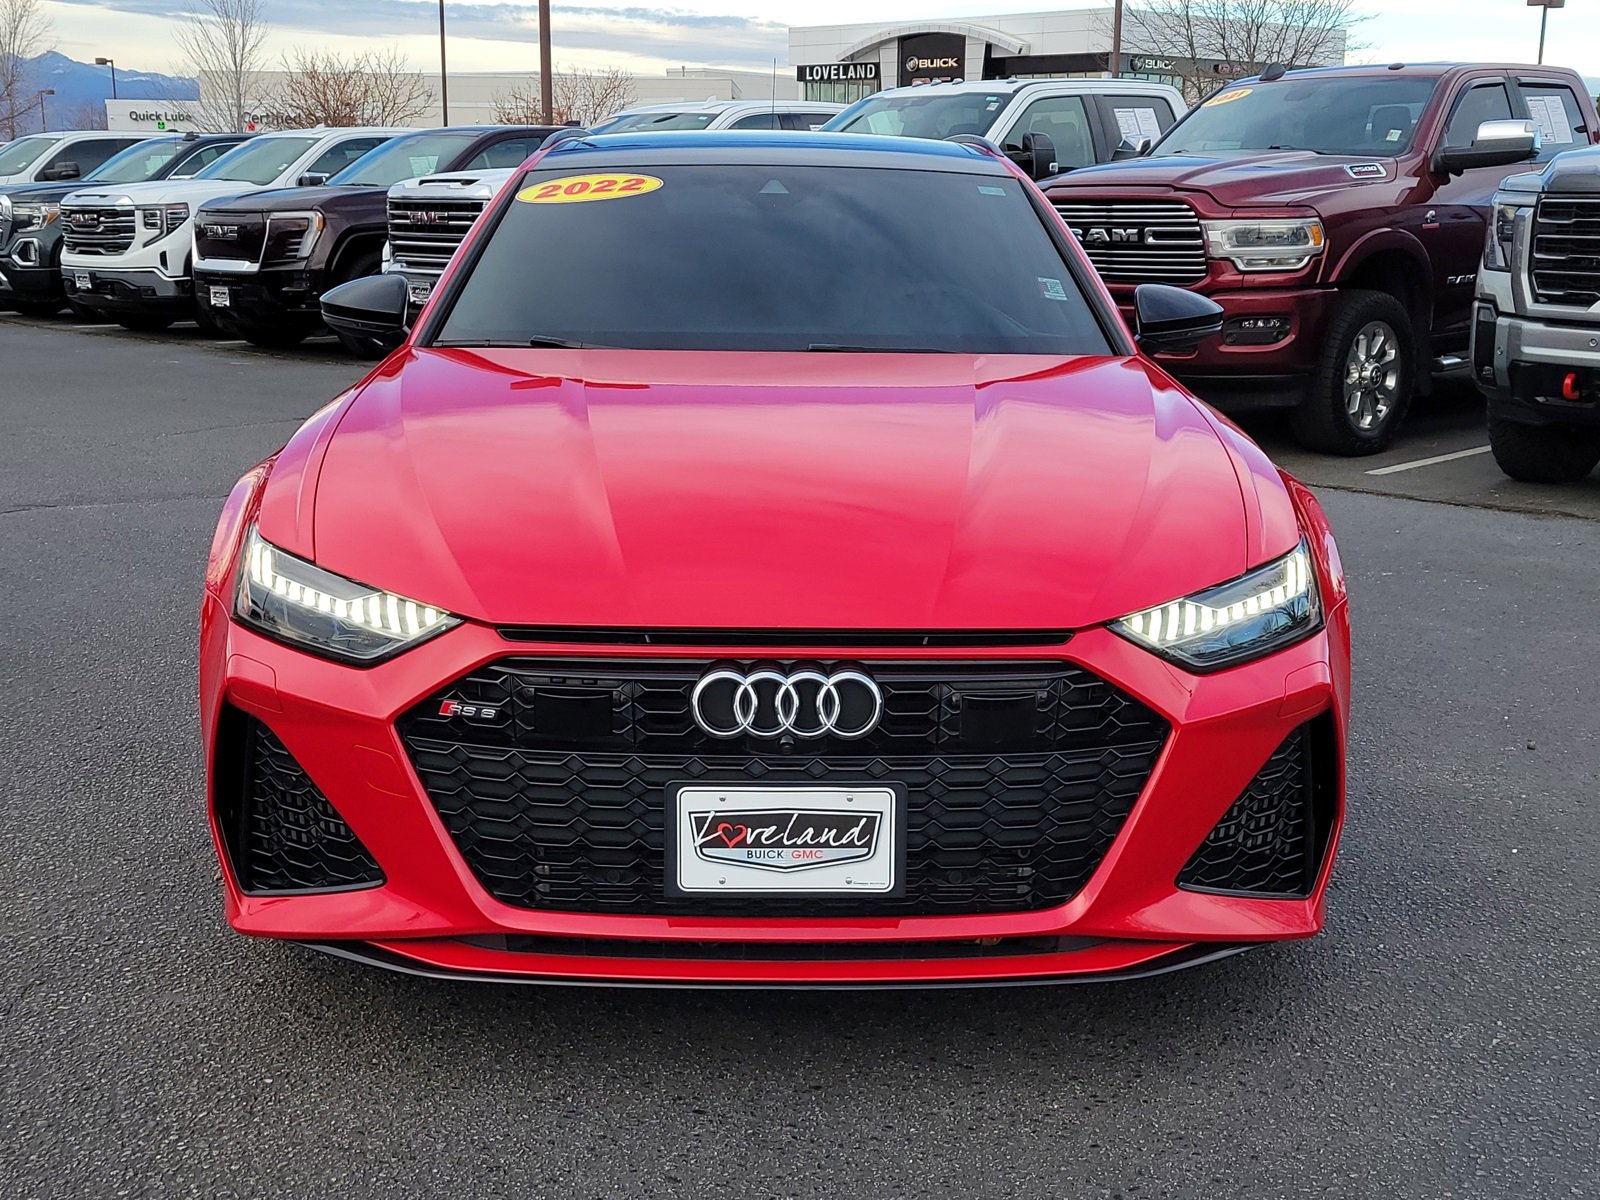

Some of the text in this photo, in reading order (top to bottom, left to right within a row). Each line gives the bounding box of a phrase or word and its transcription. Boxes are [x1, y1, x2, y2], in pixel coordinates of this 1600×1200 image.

[918, 57, 959, 69] BUICK
[1145, 59, 1177, 70] BUICK
[806, 64, 876, 80] LOVELAND
[129, 111, 192, 122] Quick Lube
[534, 178, 646, 200] 2022
[408, 211, 448, 224] GMC
[1069, 228, 1139, 241] RAM
[694, 810, 870, 848] Loveland
[746, 849, 824, 859] BUICK GMC
